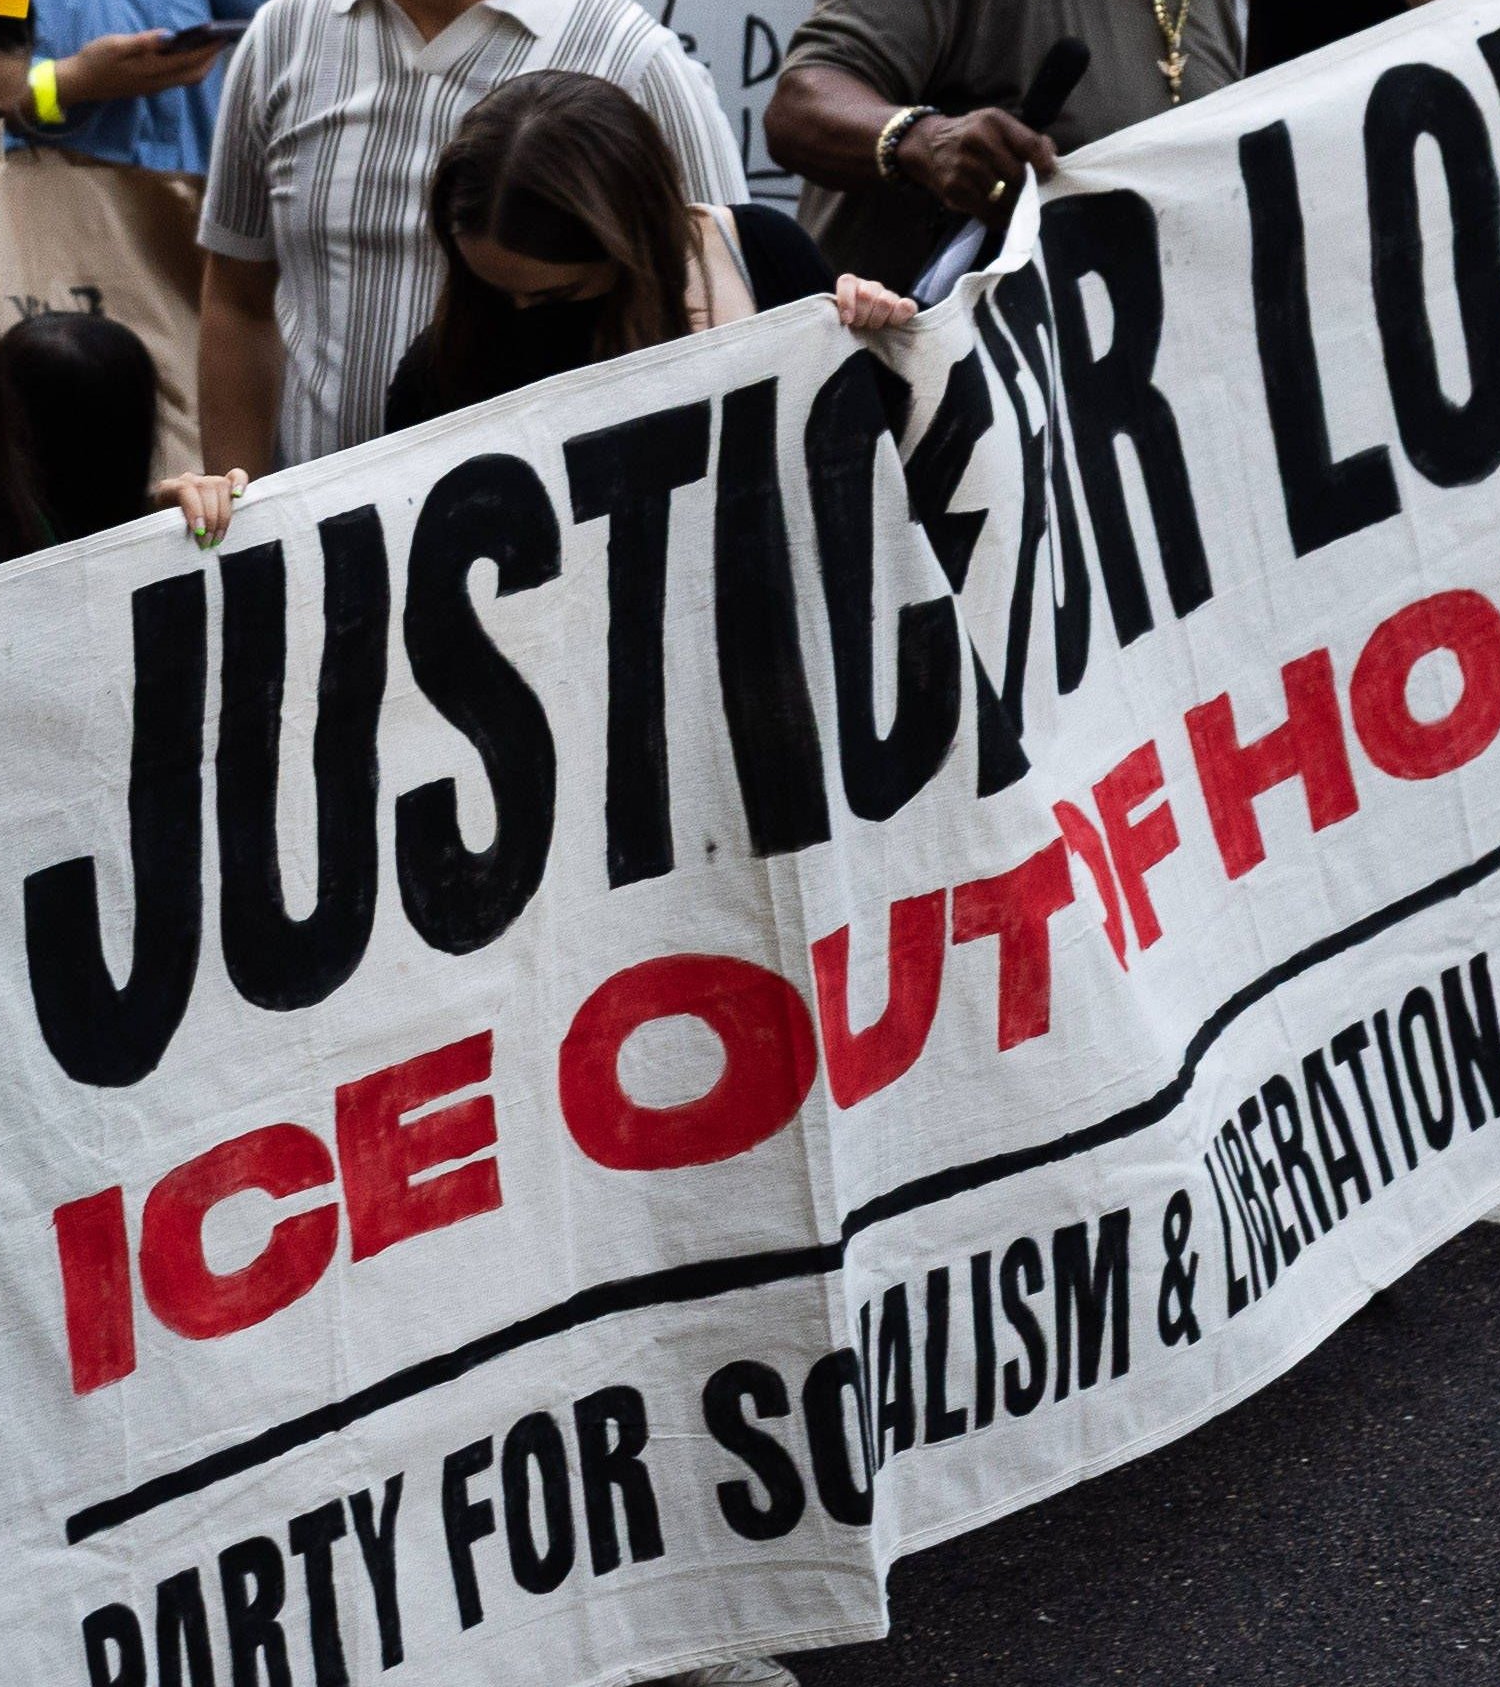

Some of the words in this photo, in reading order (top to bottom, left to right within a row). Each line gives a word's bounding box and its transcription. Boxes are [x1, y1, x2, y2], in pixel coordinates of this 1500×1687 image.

[51, 1029, 504, 1398] ICE
[558, 832, 1077, 1172] OUT
[439, 1383, 665, 1634] FOR
[1155, 1188, 1202, 1348] &
